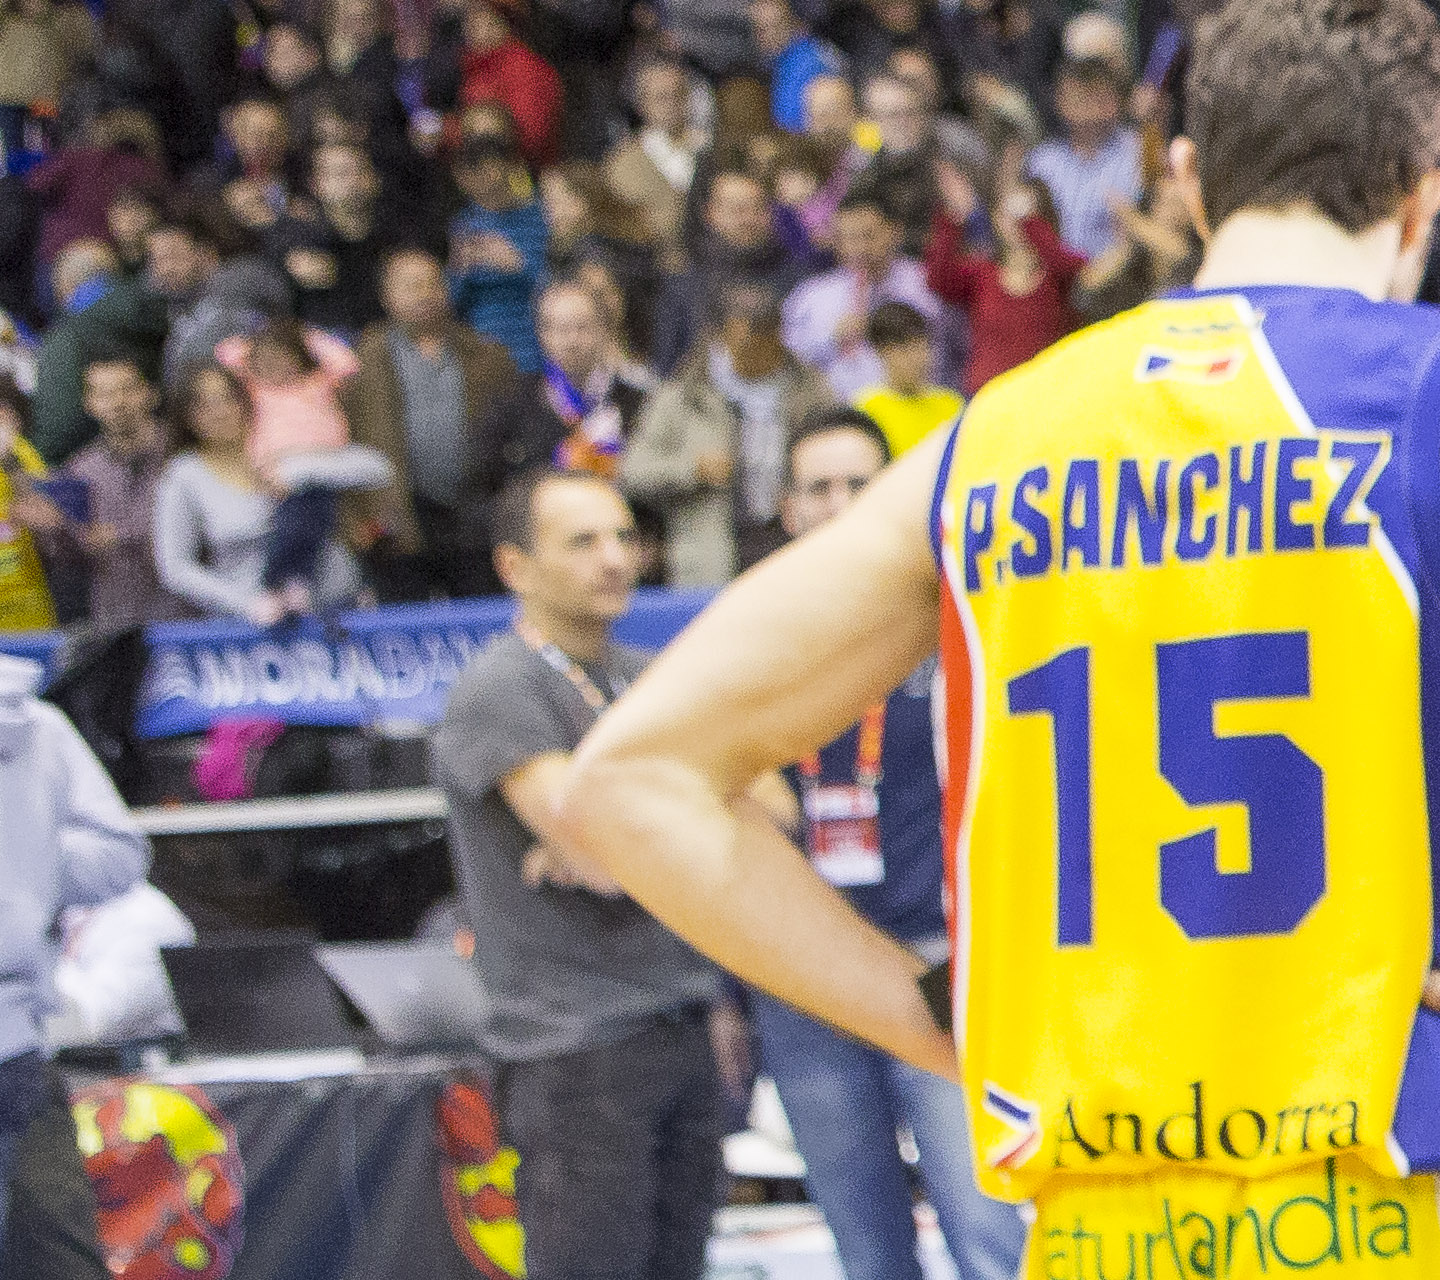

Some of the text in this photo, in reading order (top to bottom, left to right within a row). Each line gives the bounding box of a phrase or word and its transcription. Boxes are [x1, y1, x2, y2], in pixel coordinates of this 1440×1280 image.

[963, 432, 1392, 593] P.SANCHEZ
[1007, 631, 1327, 948] 15
[1051, 1081, 1360, 1167] Andorra
